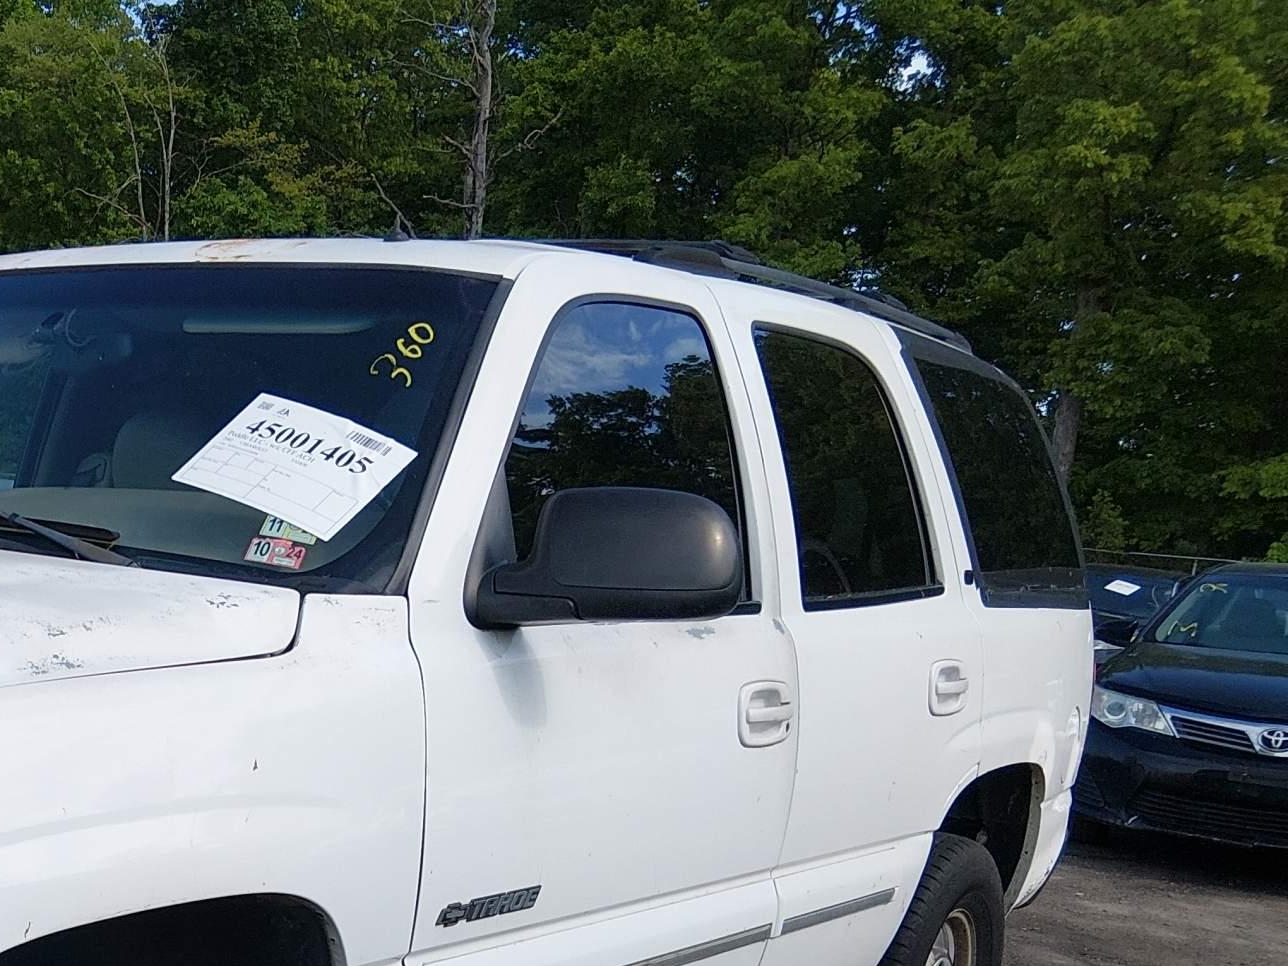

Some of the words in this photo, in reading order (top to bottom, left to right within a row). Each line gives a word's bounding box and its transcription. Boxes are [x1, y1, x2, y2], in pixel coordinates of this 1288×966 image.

[369, 322, 435, 388] 360
[246, 419, 374, 474] 45001405
[253, 540, 272, 557] 10
[285, 546, 303, 560] 24
[467, 885, 542, 922] TAHOE
